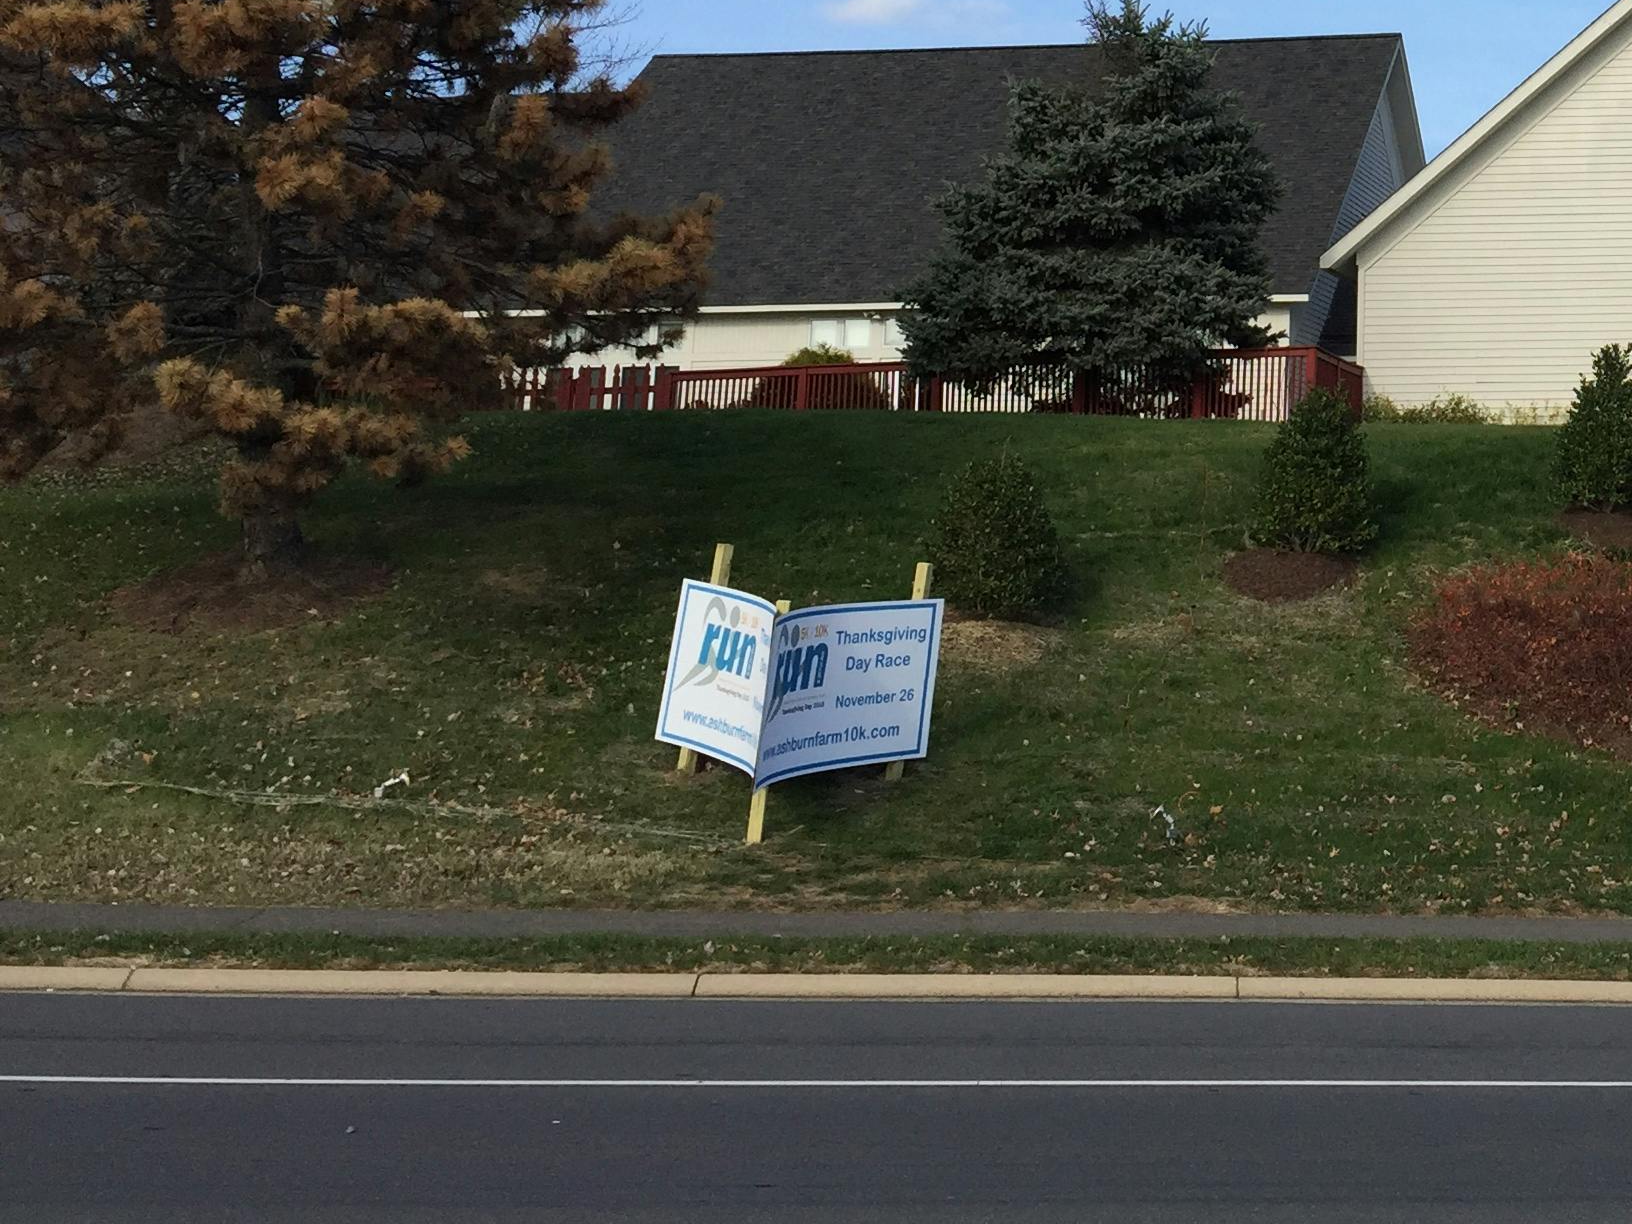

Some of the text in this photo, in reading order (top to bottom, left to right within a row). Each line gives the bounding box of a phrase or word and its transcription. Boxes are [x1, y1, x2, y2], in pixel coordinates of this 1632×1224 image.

[836, 626, 927, 647] Thanksgiving
[699, 622, 757, 680] run
[772, 642, 829, 695] run
[845, 653, 911, 673] Day Race
[835, 691, 896, 709] November
[899, 688, 914, 702] 26
